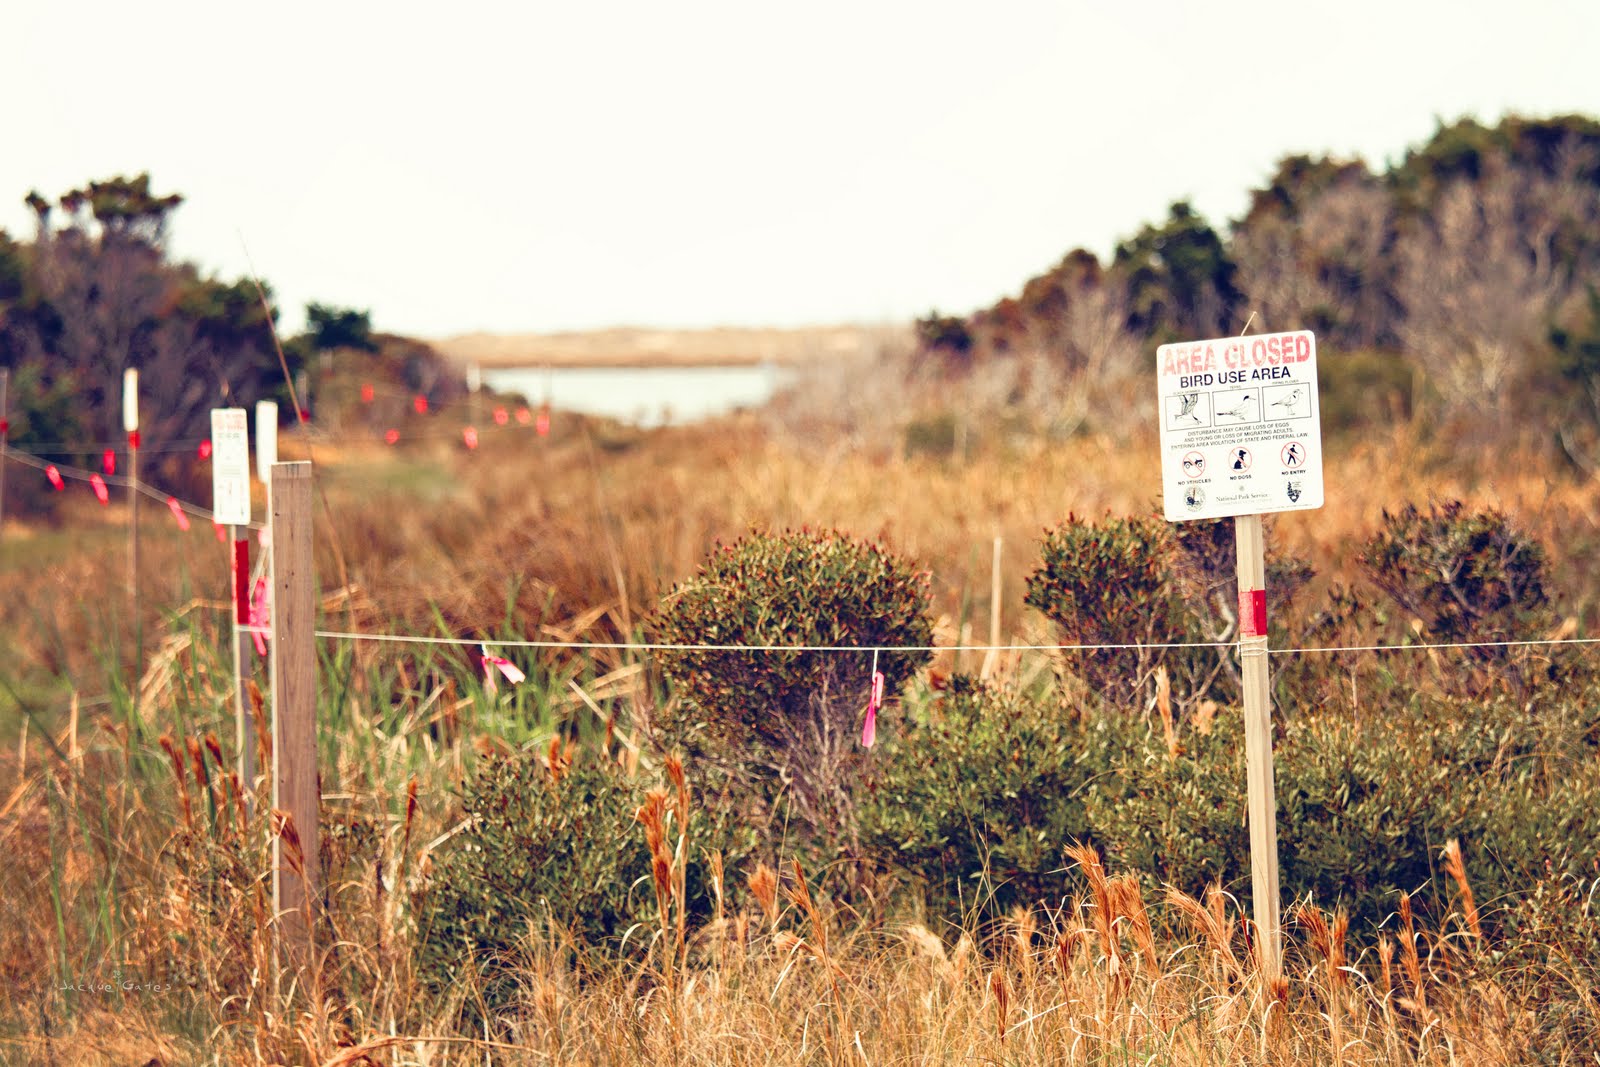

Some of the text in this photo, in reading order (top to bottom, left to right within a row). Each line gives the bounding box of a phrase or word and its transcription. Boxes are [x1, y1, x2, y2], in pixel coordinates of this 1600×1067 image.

[1163, 335, 1311, 376] AREA CLOSED
[1180, 366, 1291, 388] BIRD USE AREA
[1188, 428, 1222, 436] DISTURBANCE
